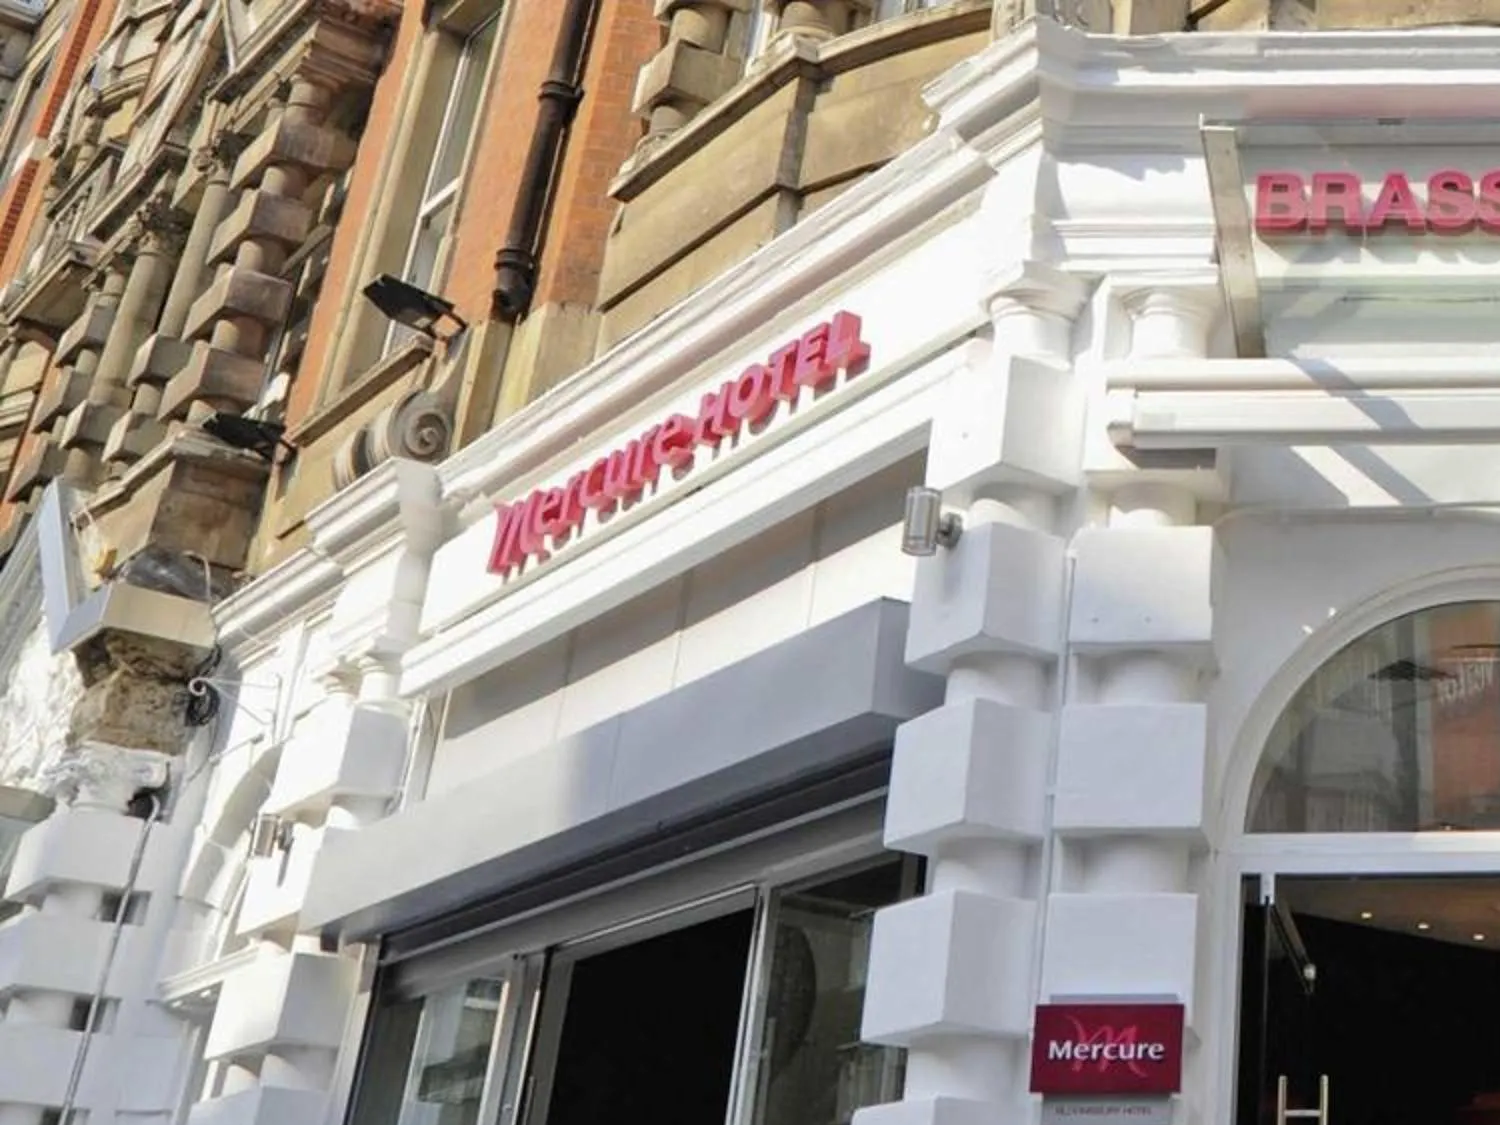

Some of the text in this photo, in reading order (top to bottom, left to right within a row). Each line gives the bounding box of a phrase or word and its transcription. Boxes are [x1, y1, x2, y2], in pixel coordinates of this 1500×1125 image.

[486, 309, 871, 576] Mercure HOTEL
[1048, 1039, 1166, 1061] Mercure
